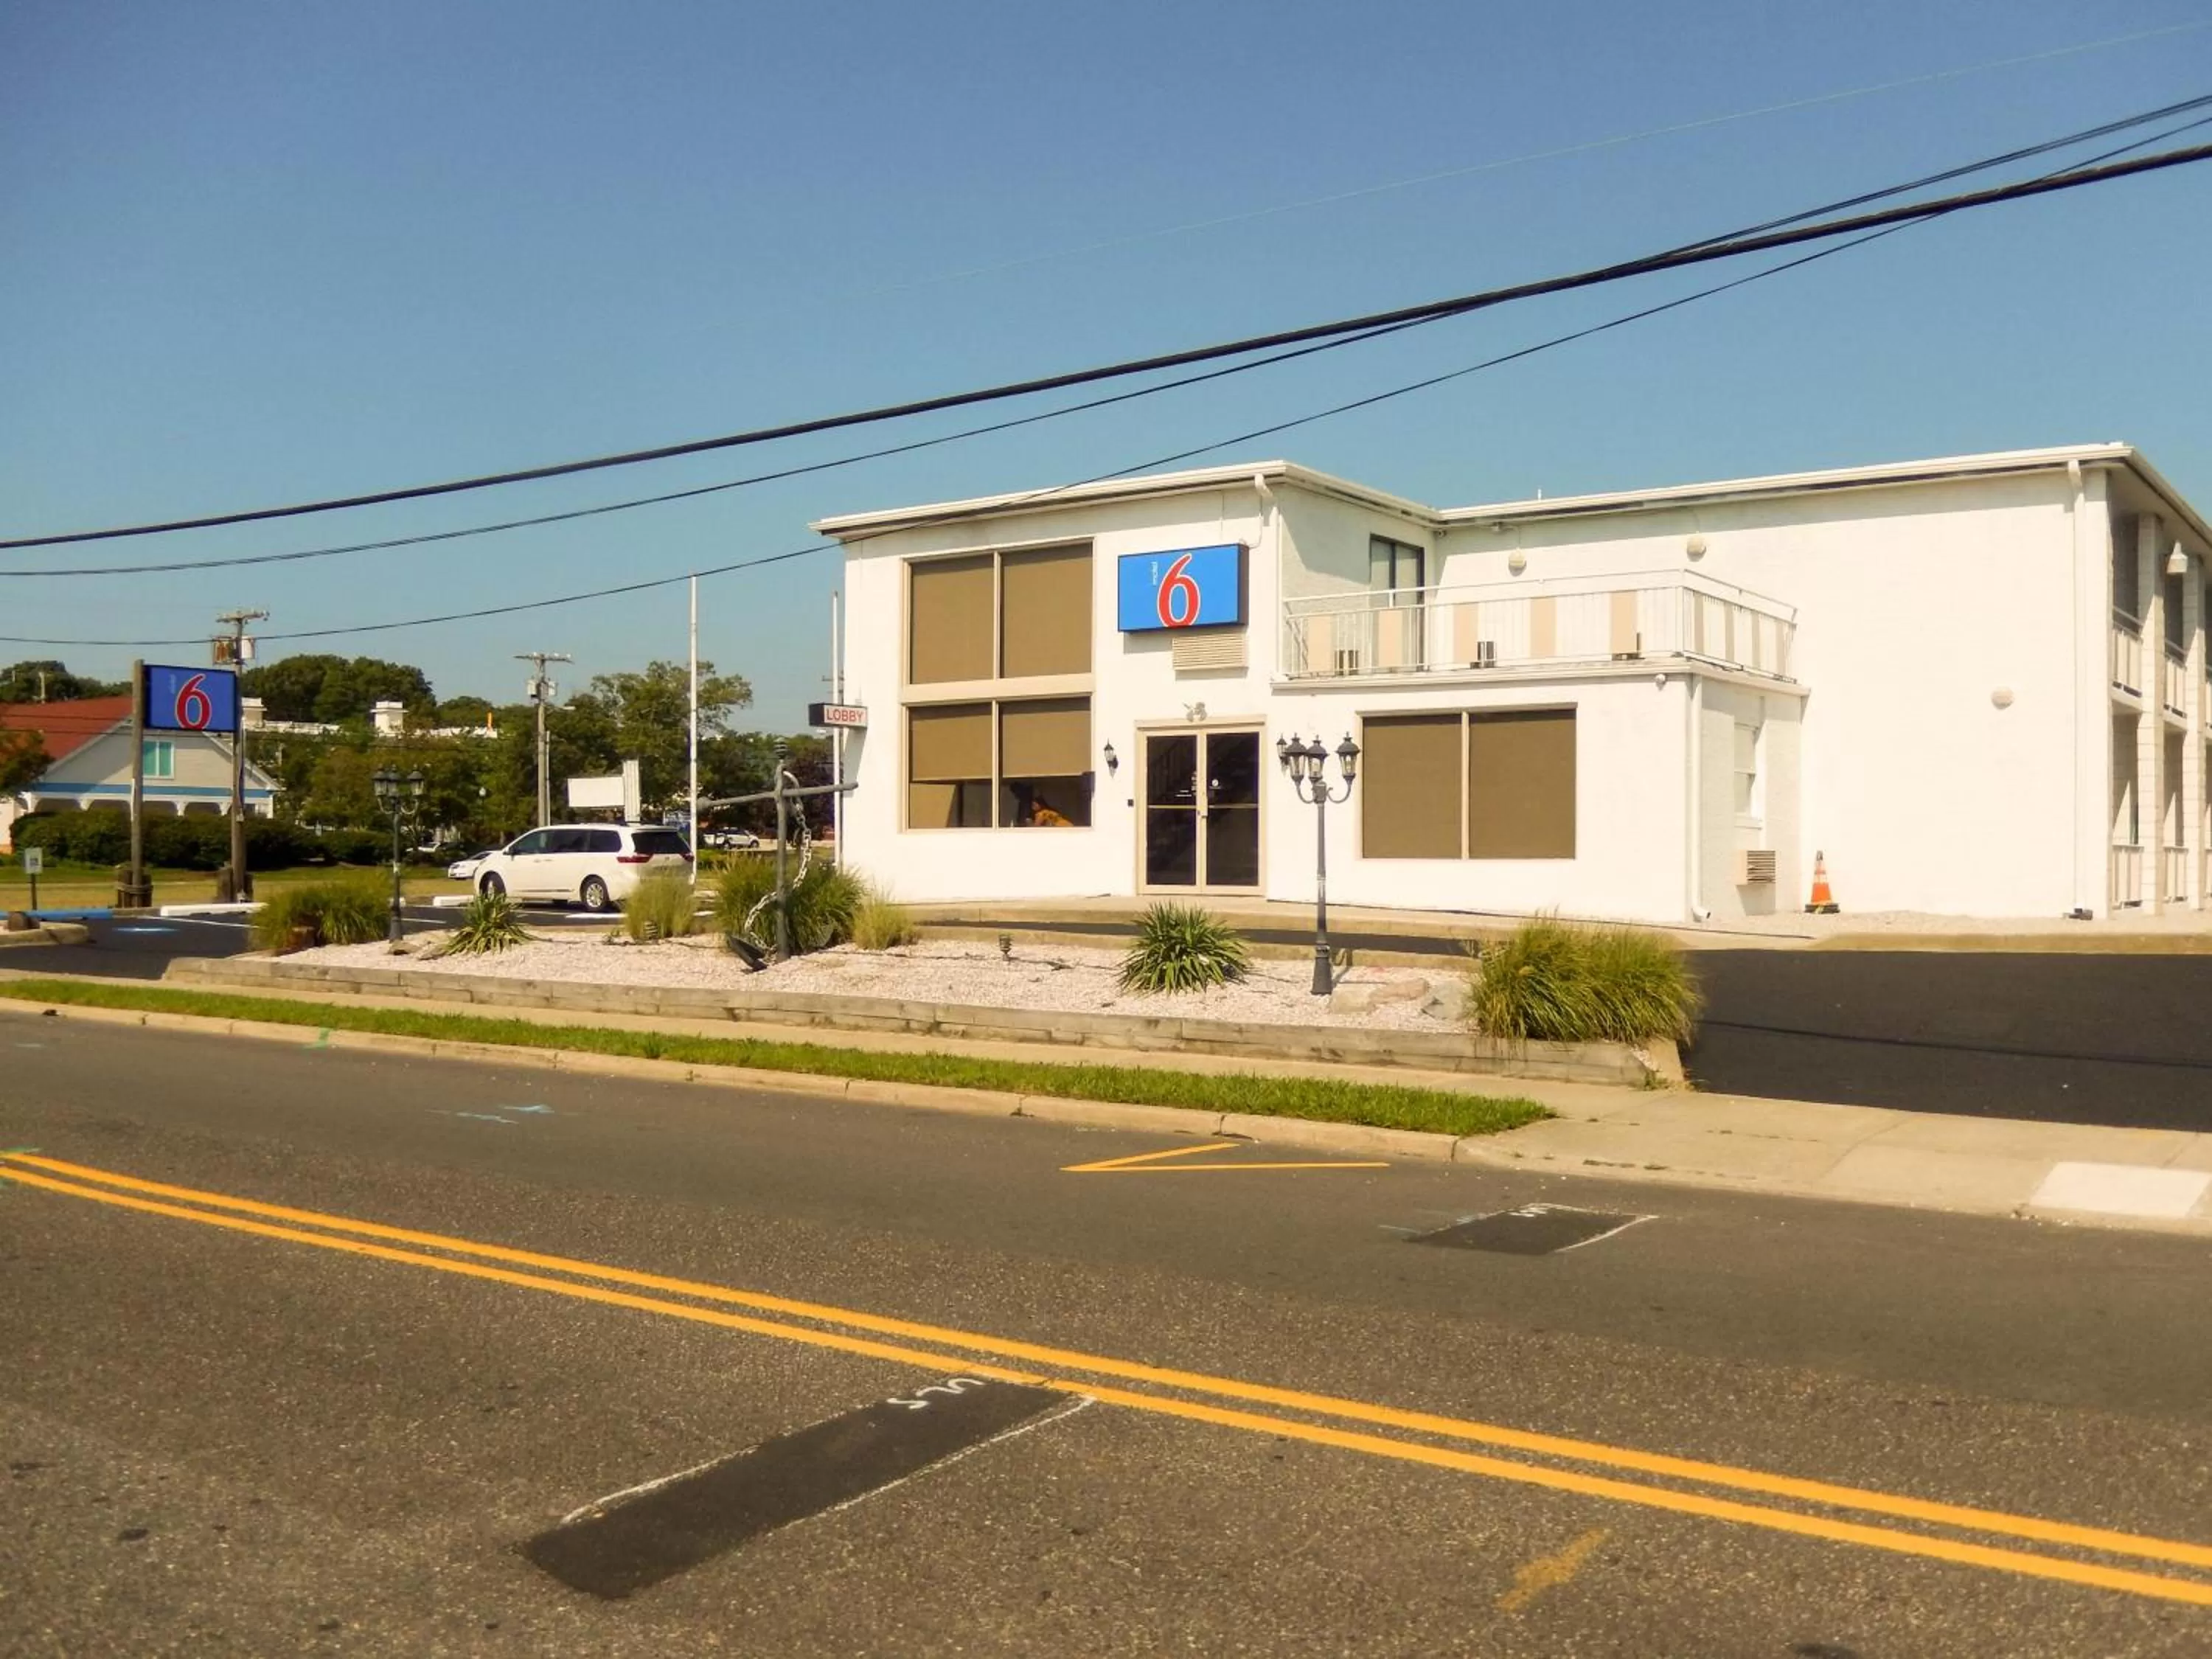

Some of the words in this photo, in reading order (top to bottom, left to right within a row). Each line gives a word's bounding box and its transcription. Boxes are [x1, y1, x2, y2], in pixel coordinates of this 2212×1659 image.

[1157, 553, 1201, 627] 6
[174, 673, 212, 731] 6
[826, 708, 864, 723] LOBBY
